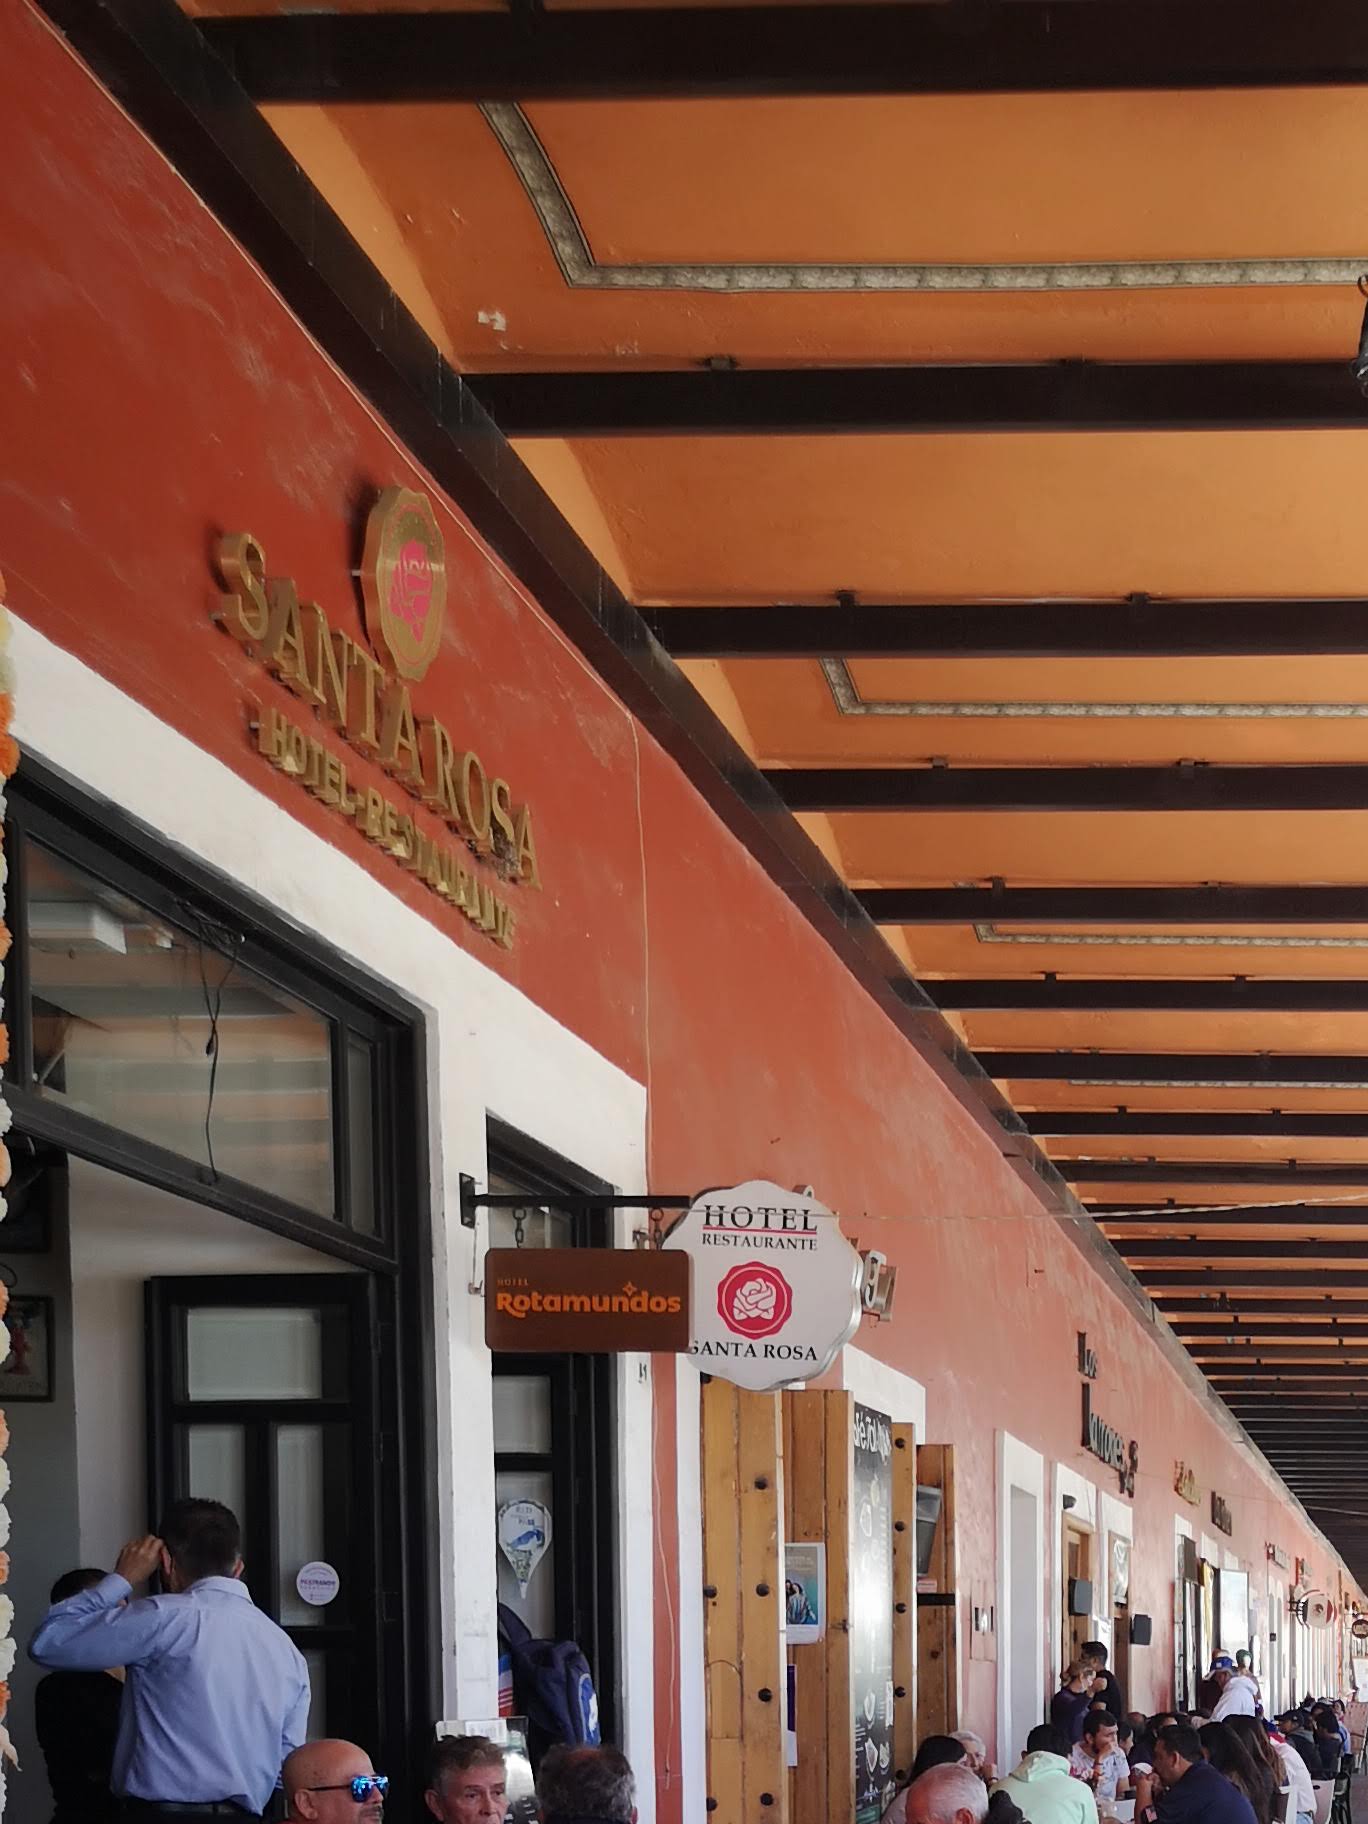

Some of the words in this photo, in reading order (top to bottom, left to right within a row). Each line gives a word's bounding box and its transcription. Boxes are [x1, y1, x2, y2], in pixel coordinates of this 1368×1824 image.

[218, 531, 425, 787] SANTA
[419, 714, 543, 893] ROSA
[704, 1205, 818, 1231] HOTEL
[702, 1233, 818, 1250] RESTAURANTE
[497, 1278, 529, 1286] HOTEL
[495, 1290, 681, 1318] Rotamundos
[763, 1344, 819, 1361] ROSA
